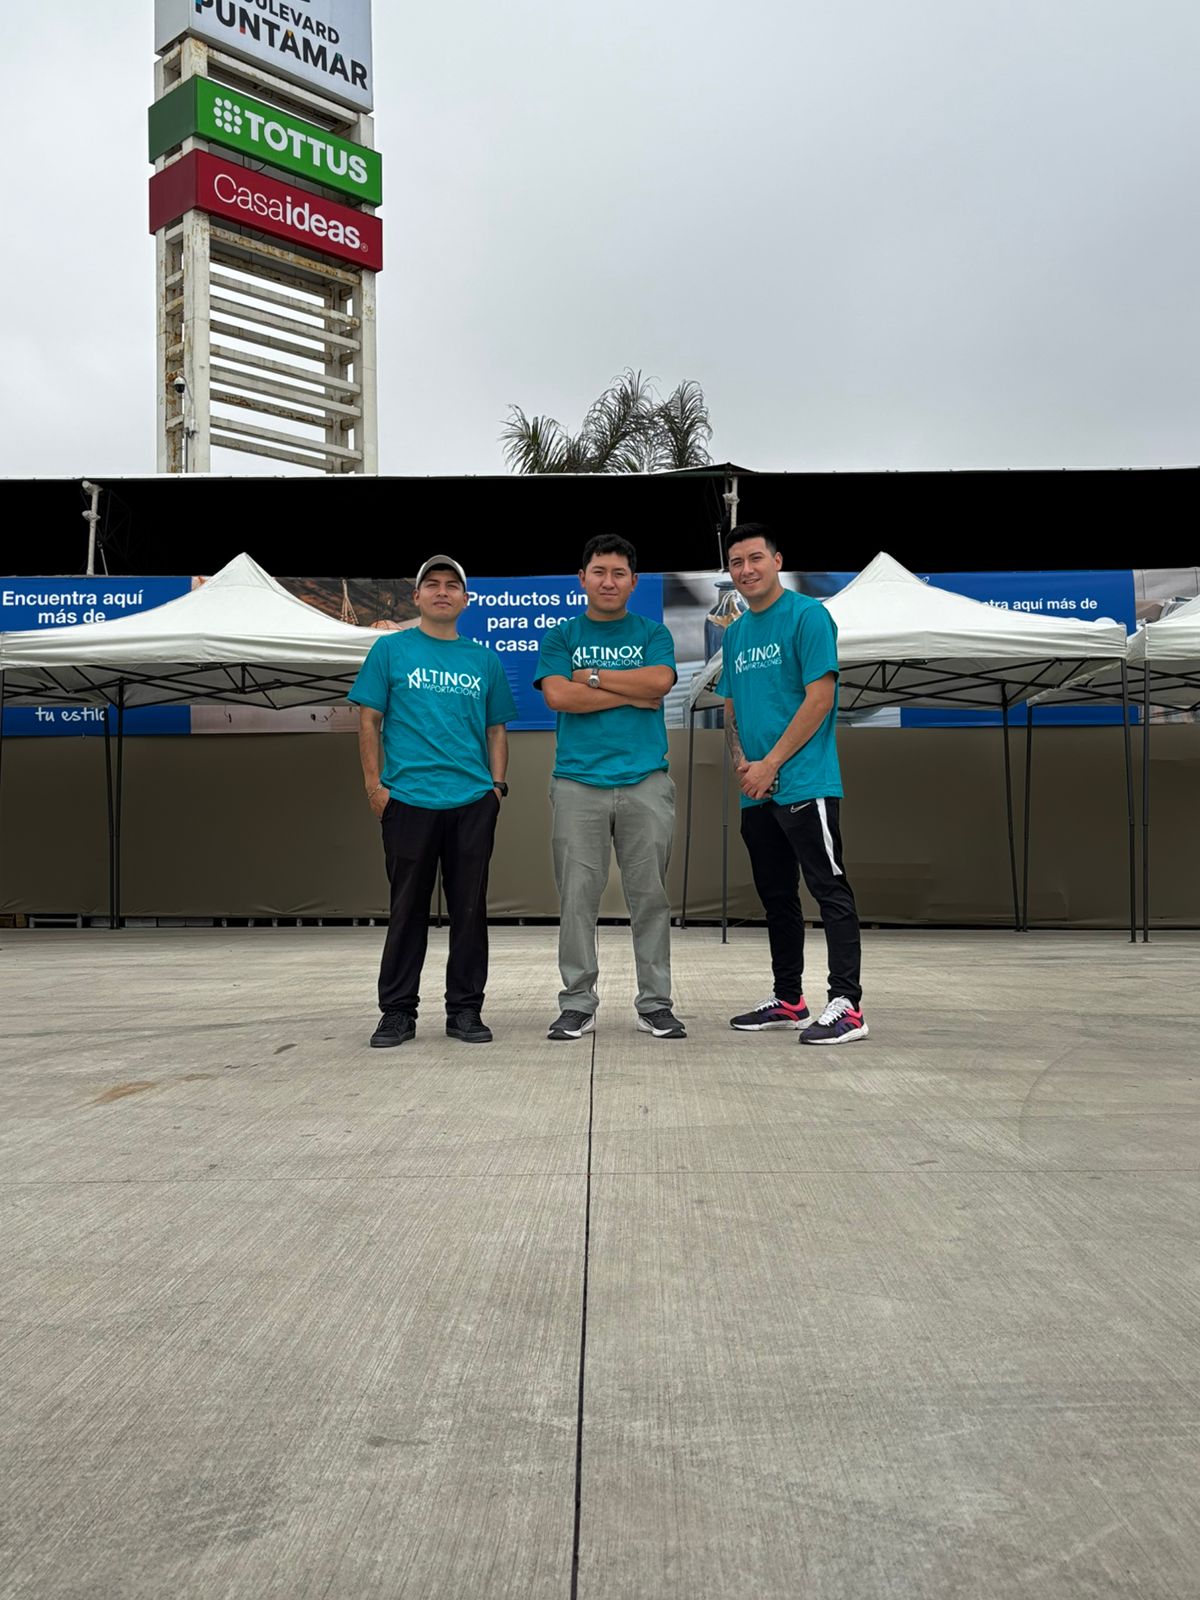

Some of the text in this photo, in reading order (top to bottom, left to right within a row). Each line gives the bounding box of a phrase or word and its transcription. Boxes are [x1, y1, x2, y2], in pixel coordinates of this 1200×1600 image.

[243, 0, 340, 44] ULEVARD
[244, 109, 369, 185] TOTTUS
[2, 589, 144, 608] Encuentra aquí
[466, 591, 560, 607] Productos
[1013, 598, 1043, 612] aquí
[1047, 598, 1077, 610] más
[1080, 598, 1098, 610] de
[38, 608, 106, 624] más de
[487, 617, 528, 632] para
[495, 639, 539, 652] casa
[572, 646, 643, 668] ALTINOX
[582, 659, 643, 668] IMPORTACIONE
[735, 643, 781, 673] ALTINOX
[407, 667, 481, 691] ALTINOX
[35, 706, 55, 722] tu
